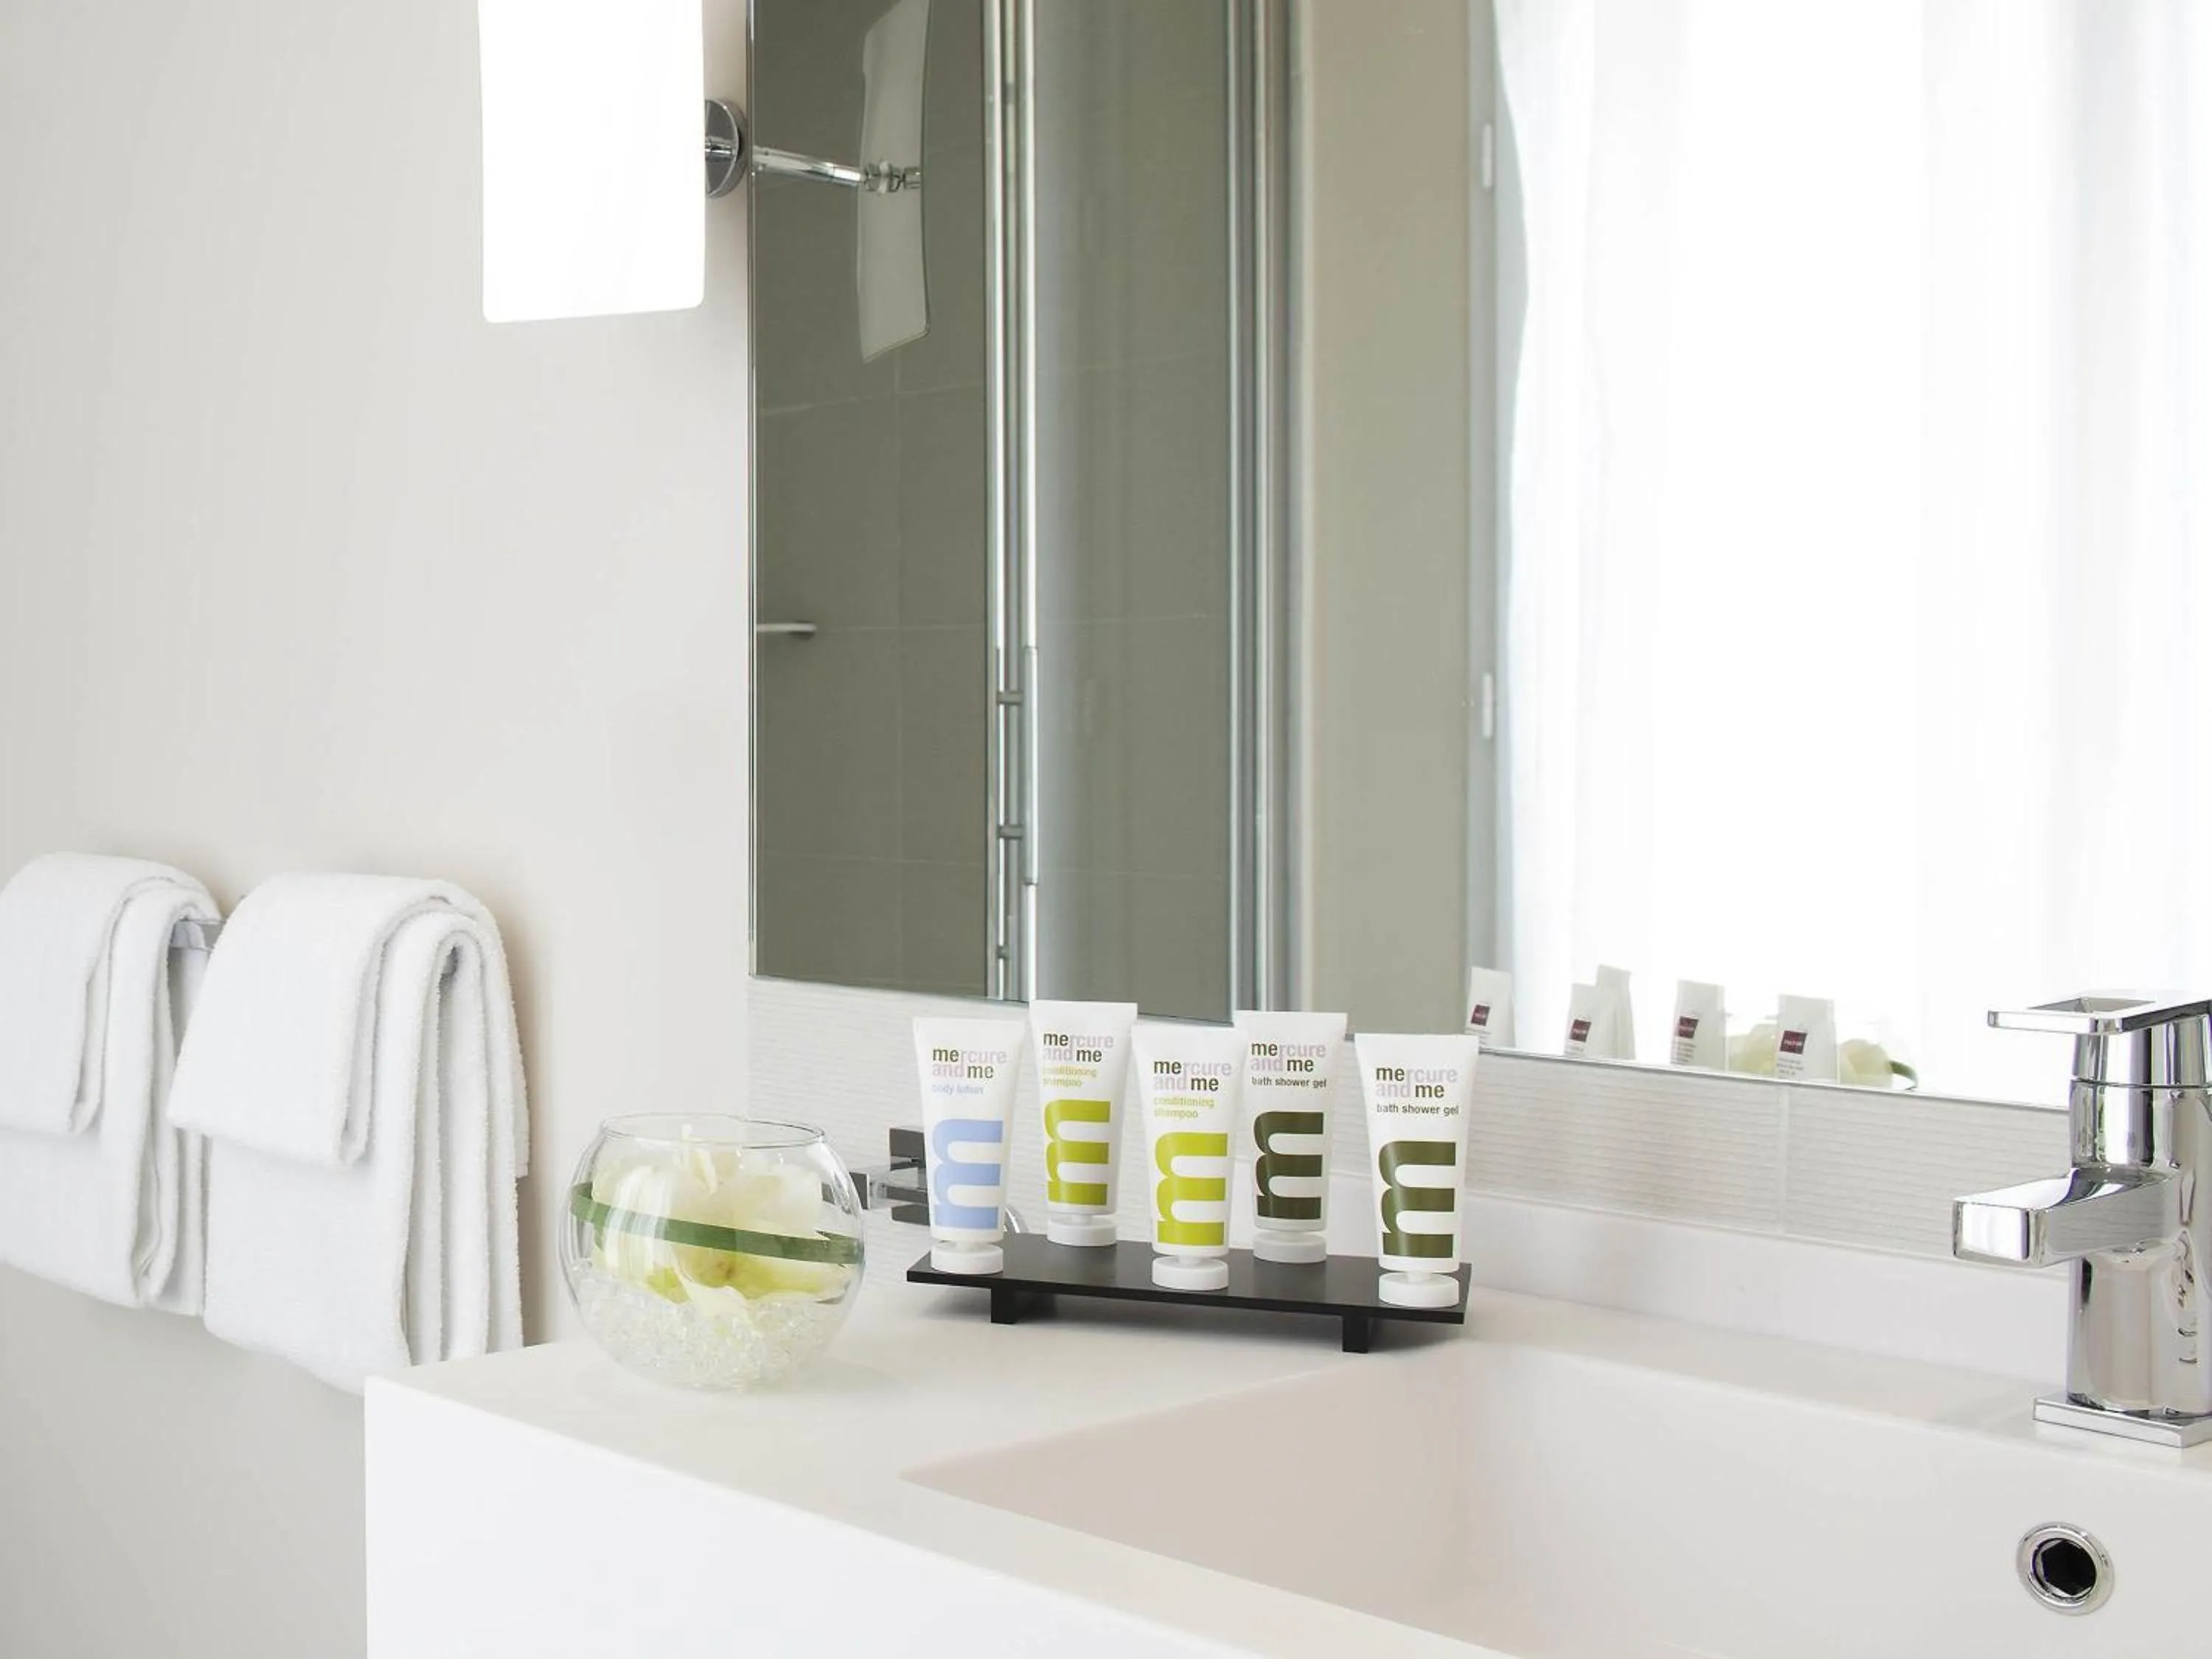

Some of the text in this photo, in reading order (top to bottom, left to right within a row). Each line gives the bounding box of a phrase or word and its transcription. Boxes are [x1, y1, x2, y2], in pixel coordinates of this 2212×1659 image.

[1044, 1032, 1113, 1048] mercure
[933, 1048, 1007, 1063] mercure
[1043, 1047, 1102, 1062] and me
[1251, 1043, 1326, 1058] mercure
[932, 1063, 994, 1079] and me
[1153, 1060, 1232, 1076] mercure
[1251, 1057, 1314, 1073] and me
[1251, 1076, 1327, 1089] bath shower gel
[1376, 1067, 1458, 1083] mercure
[1153, 1076, 1219, 1091] and me
[1376, 1082, 1444, 1099] and me
[1377, 1103, 1459, 1117] bath shower gel
